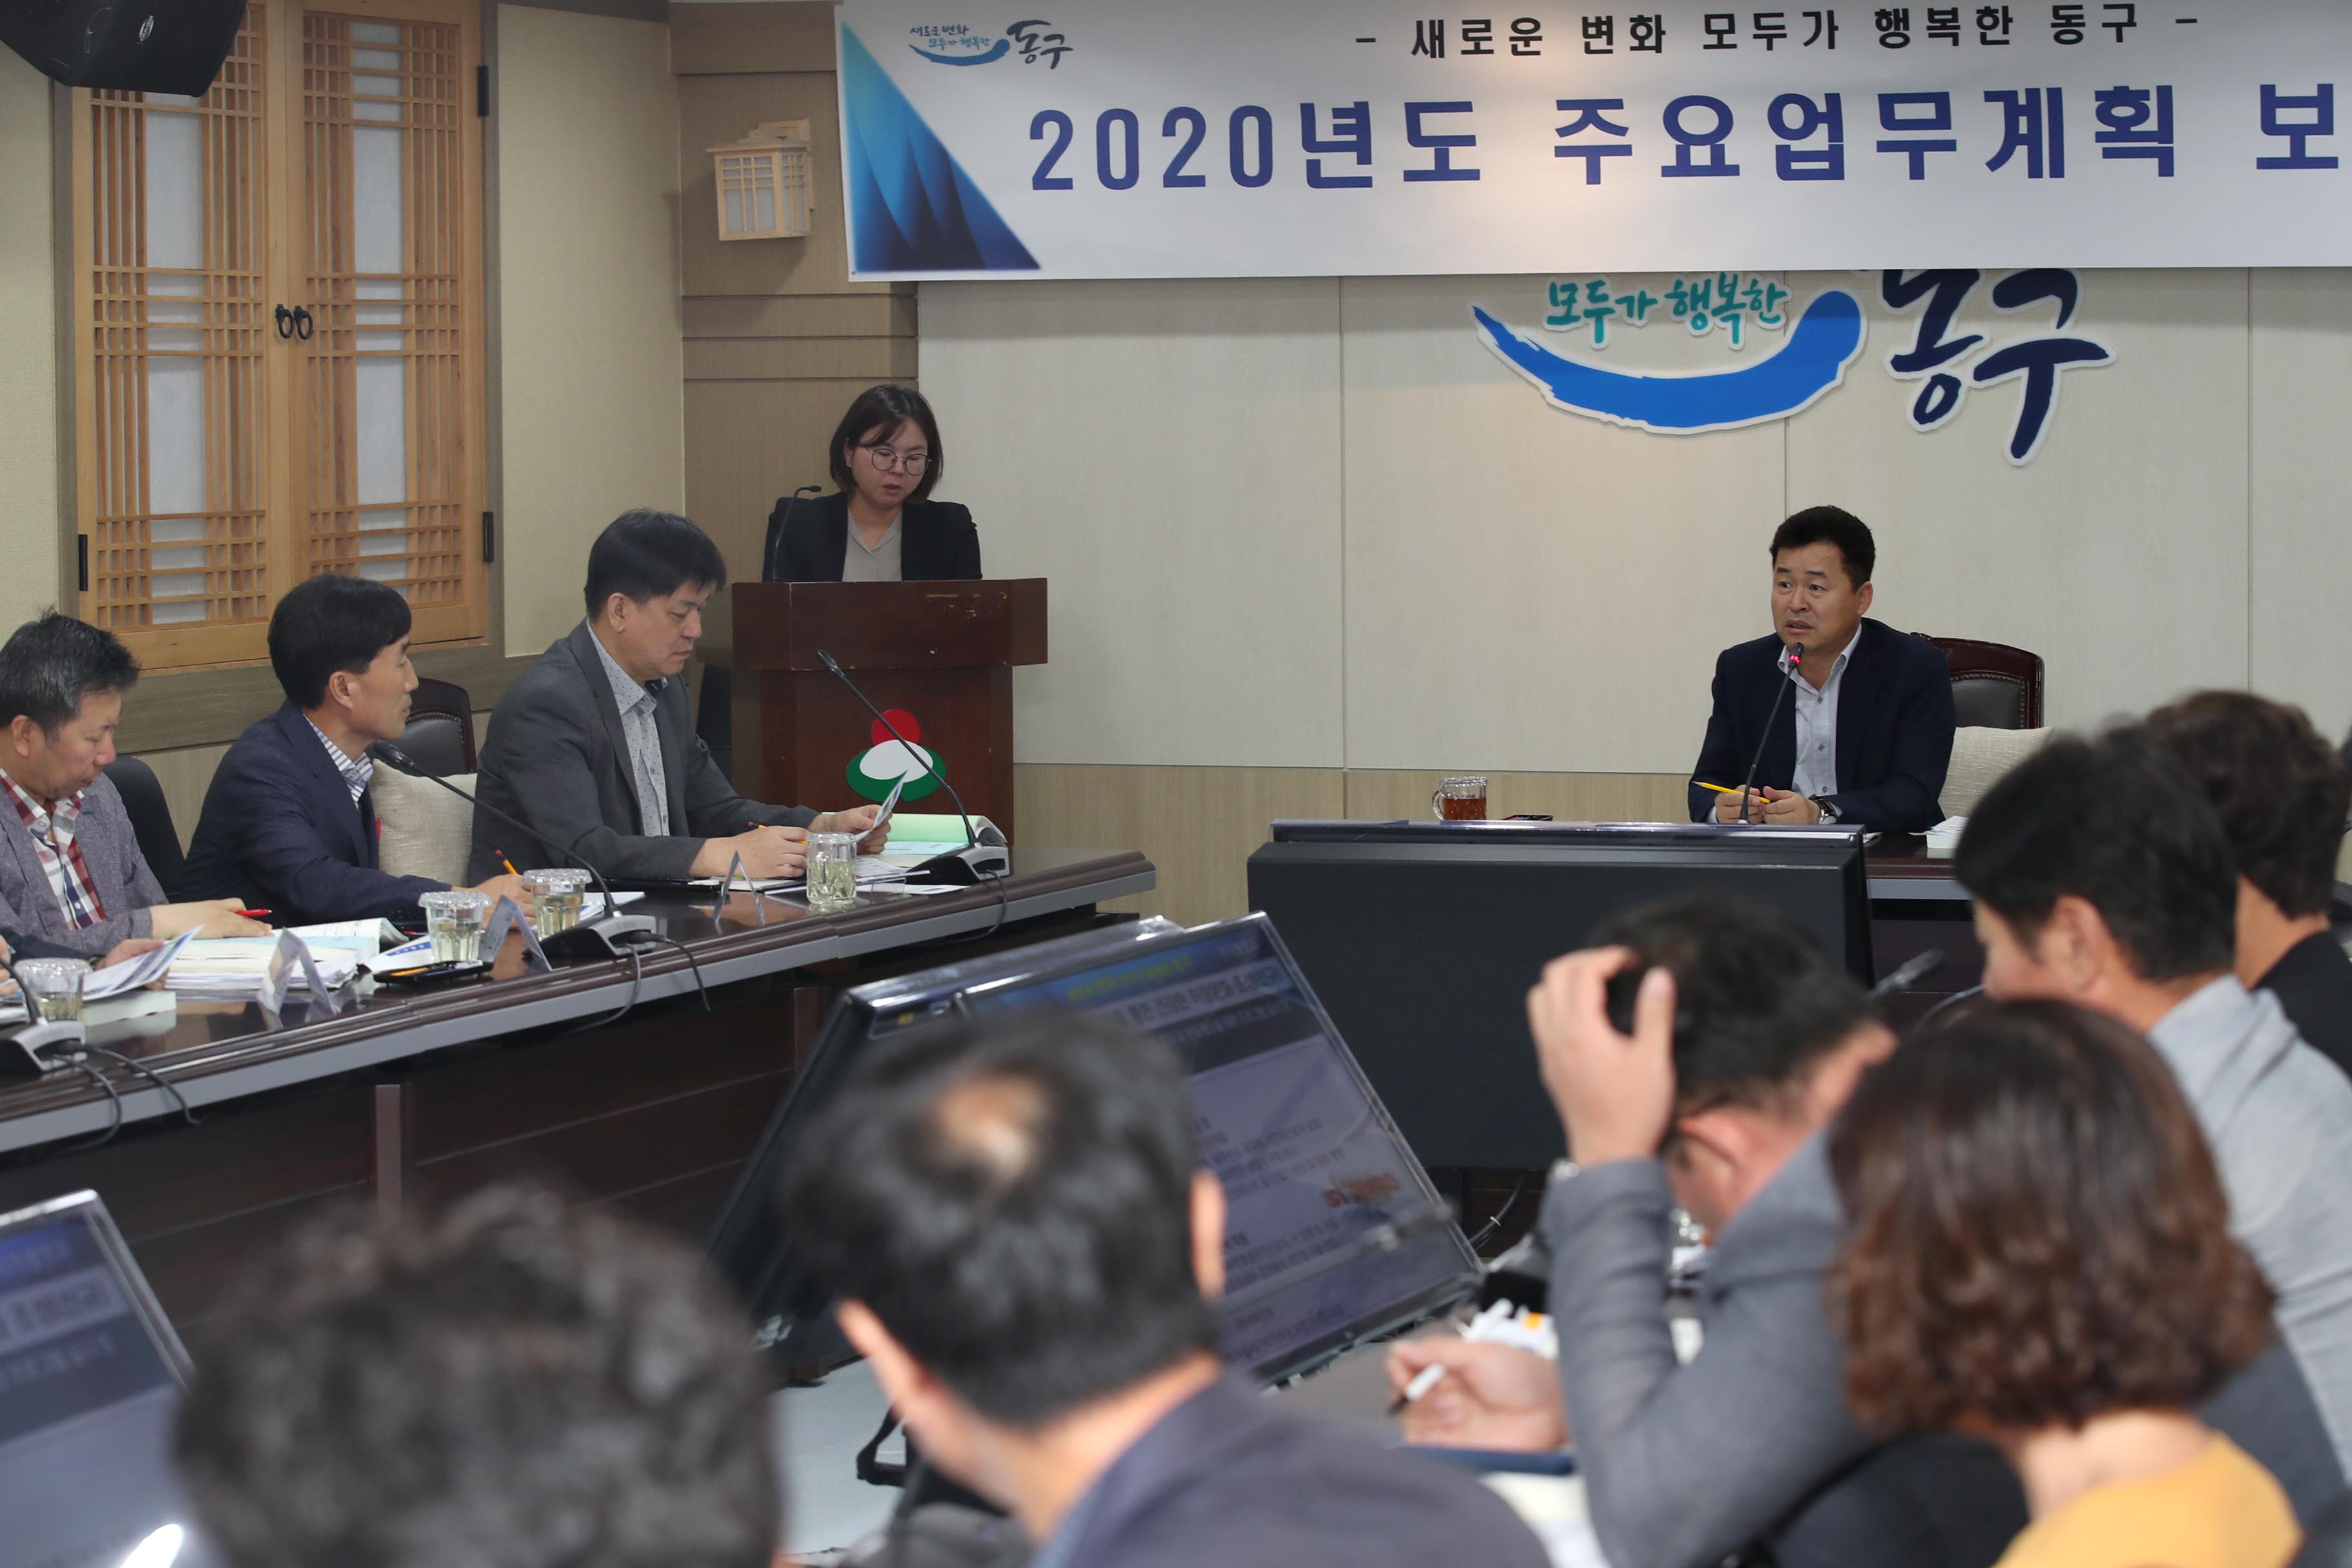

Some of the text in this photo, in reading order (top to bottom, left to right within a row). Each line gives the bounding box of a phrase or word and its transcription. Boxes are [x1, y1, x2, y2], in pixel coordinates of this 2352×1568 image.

[910, 24, 969, 37] 새로운 변화
[929, 36, 990, 50] 모두가 행복한
[1006, 19, 1073, 70] 동구
[1411, 17, 1542, 59] 새로운
[1582, 14, 1666, 54] 변화
[1703, 9, 1839, 51] 모두가
[1874, 6, 2013, 49] 행복한
[2050, 3, 2137, 45] 동구
[1030, 101, 1480, 191] 2020년도
[1554, 84, 2175, 185] 주요업무계획
[1547, 271, 1788, 344] 모두가 행복한
